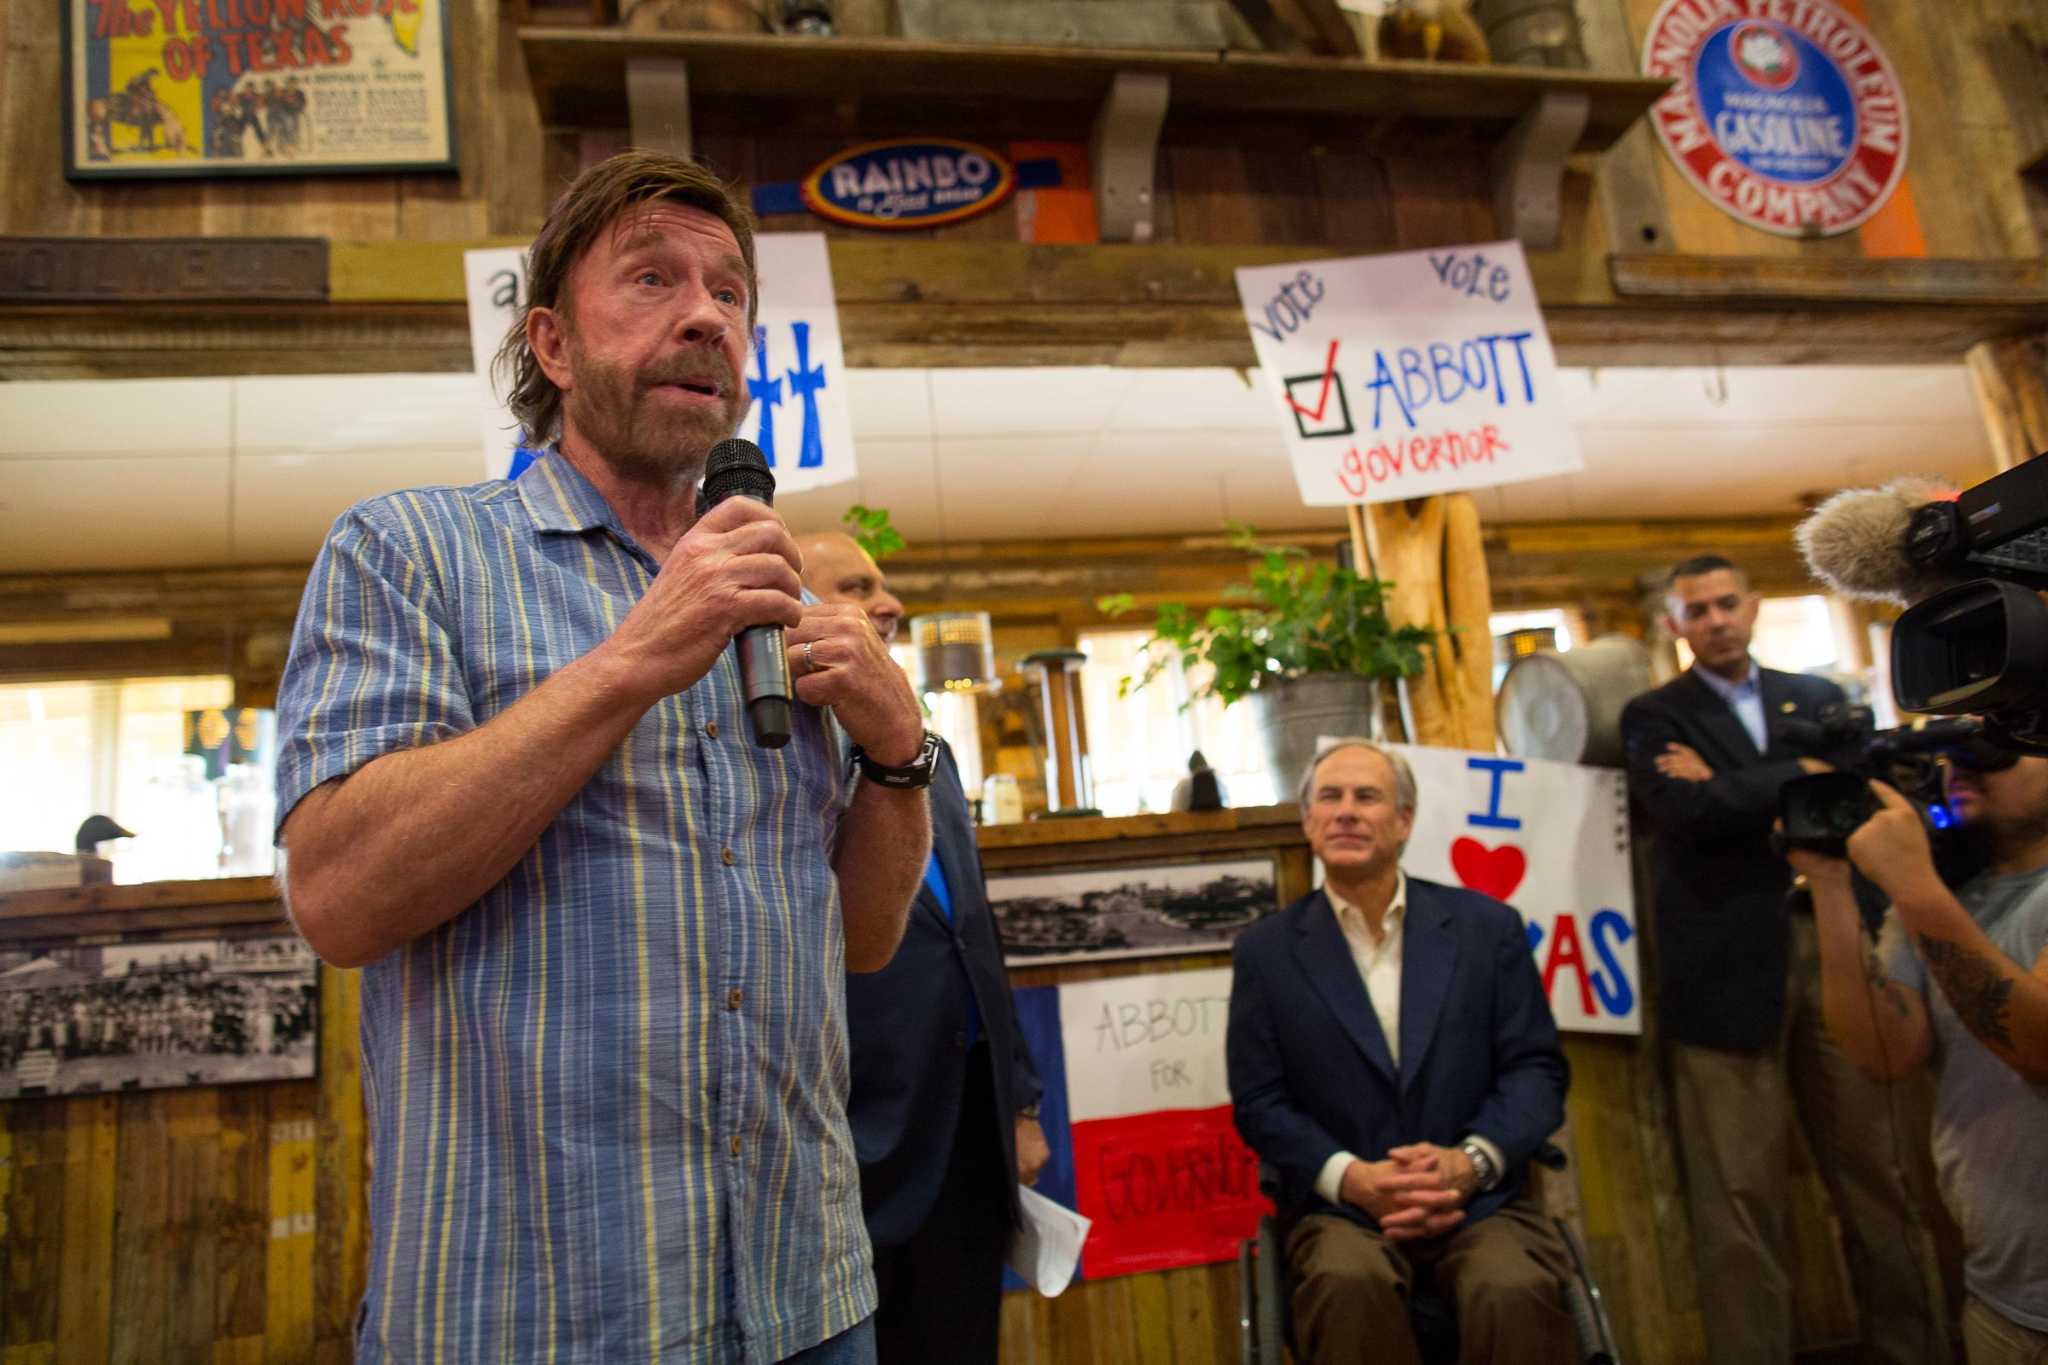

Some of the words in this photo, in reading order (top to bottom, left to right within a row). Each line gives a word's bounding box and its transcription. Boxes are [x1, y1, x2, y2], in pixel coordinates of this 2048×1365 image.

[163, 35, 212, 82] OF
[221, 25, 353, 77] TEXAS
[831, 152, 991, 199] RAINBO
[1708, 160, 1881, 226] COMPANY
[1365, 331, 1533, 430] ABBOTT
[1467, 758, 1525, 830] I
